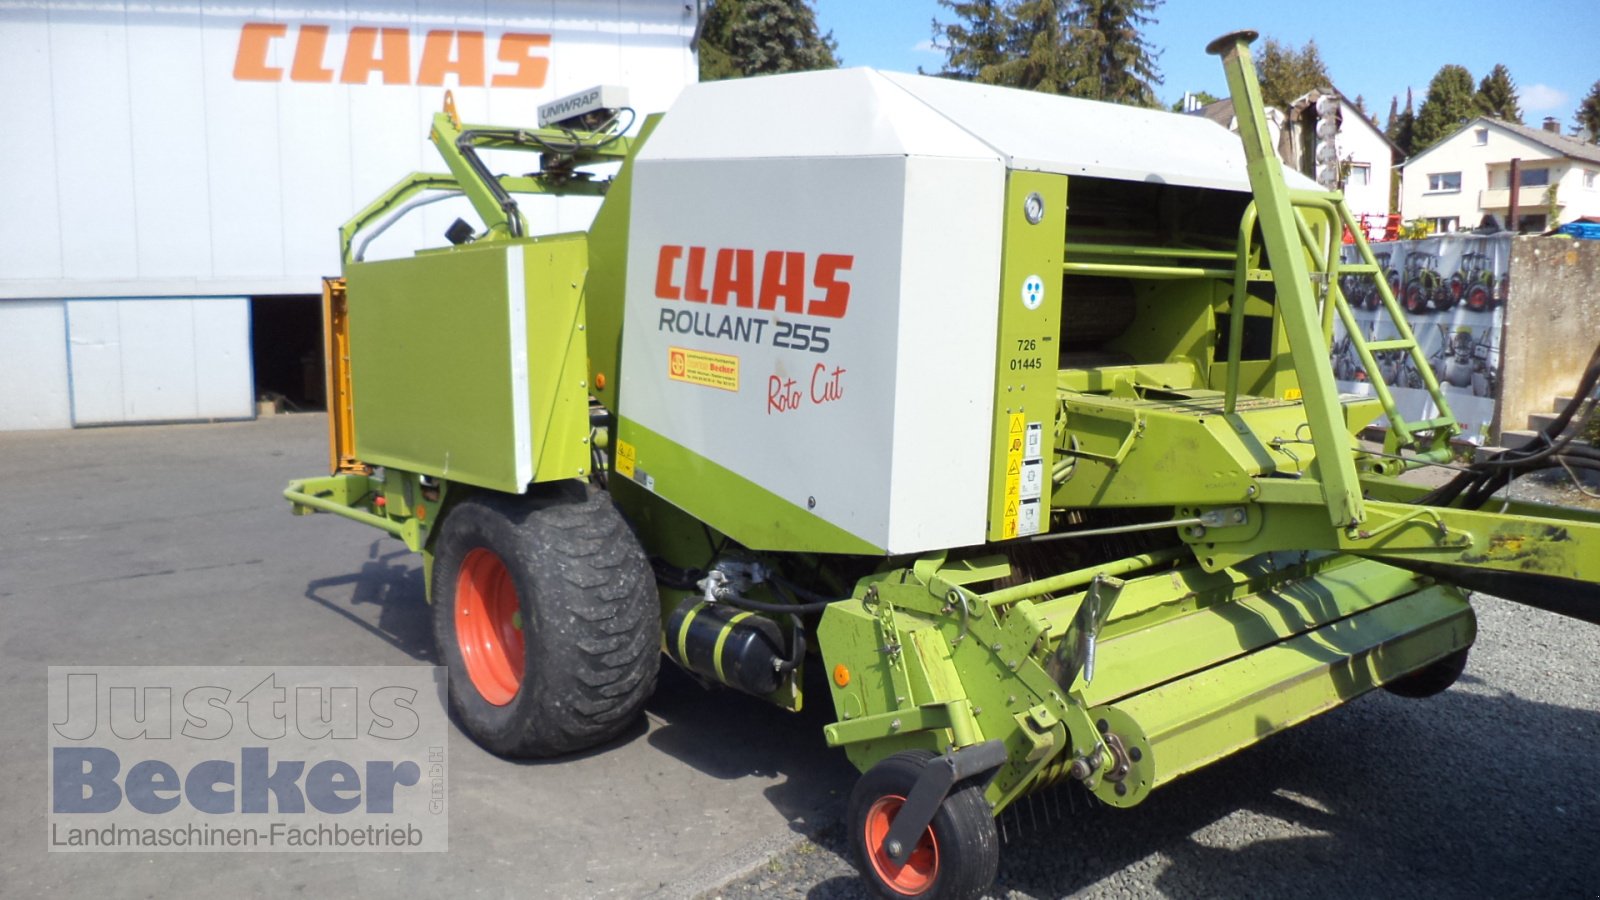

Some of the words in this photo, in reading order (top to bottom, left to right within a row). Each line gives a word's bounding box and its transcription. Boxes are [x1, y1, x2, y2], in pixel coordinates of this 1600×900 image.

[233, 22, 552, 89] CLAAS
[541, 91, 599, 119] UNIWRAP
[655, 244, 854, 319] CLAAS
[658, 307, 769, 344] ROLLANT
[772, 320, 831, 354] 255
[1017, 339, 1036, 351] 726
[1010, 357, 1042, 371] 01445
[768, 374, 803, 415] Roto
[810, 362, 847, 404] Cut
